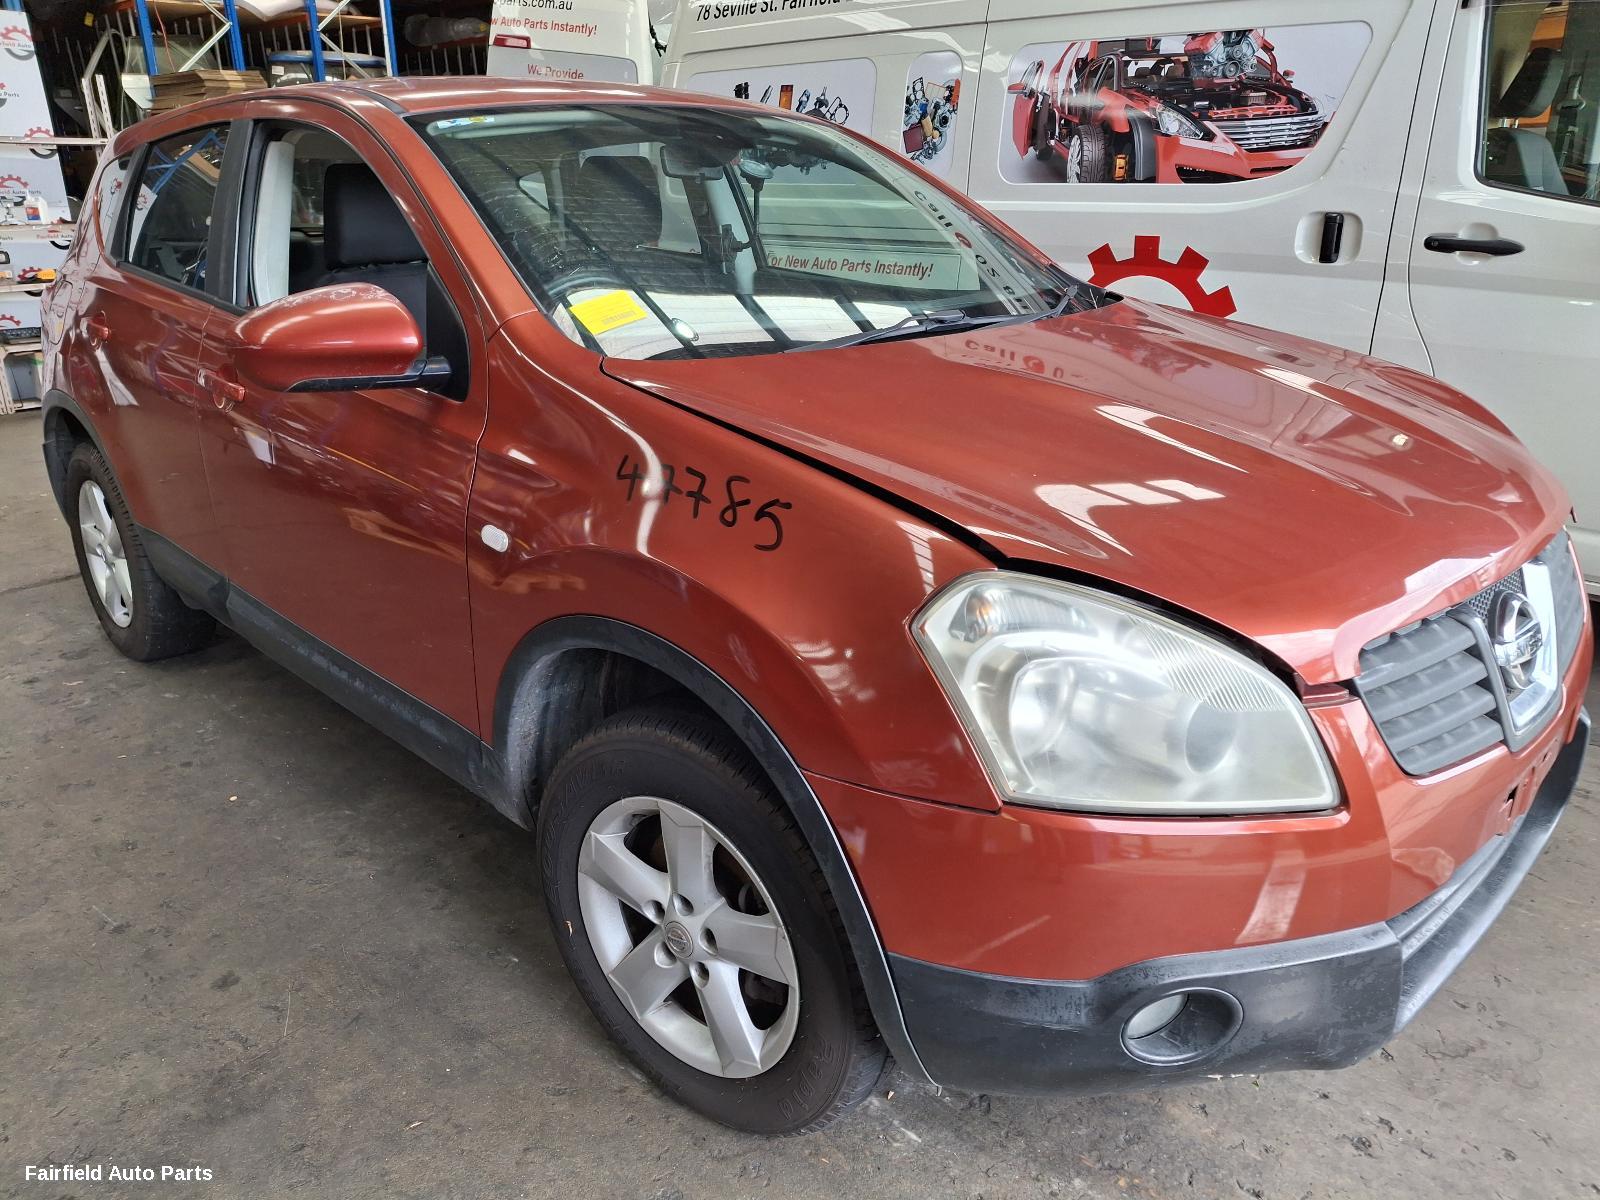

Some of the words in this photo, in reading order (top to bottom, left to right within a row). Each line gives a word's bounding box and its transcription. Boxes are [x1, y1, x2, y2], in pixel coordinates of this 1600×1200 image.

[493, 0, 573, 10] parts.com.au
[696, 4, 712, 21] 78
[714, 1, 757, 19] Seville
[501, 16, 521, 28] Auto
[523, 18, 548, 30] Parts
[550, 20, 598, 37] Instantly!
[527, 63, 542, 76] We
[545, 66, 584, 80] Provide
[766, 251, 784, 267] For
[785, 254, 809, 270] New
[811, 256, 838, 271] Auto
[840, 258, 871, 274] Parts
[873, 260, 934, 281] Instantly!
[616, 454, 793, 552] 47785
